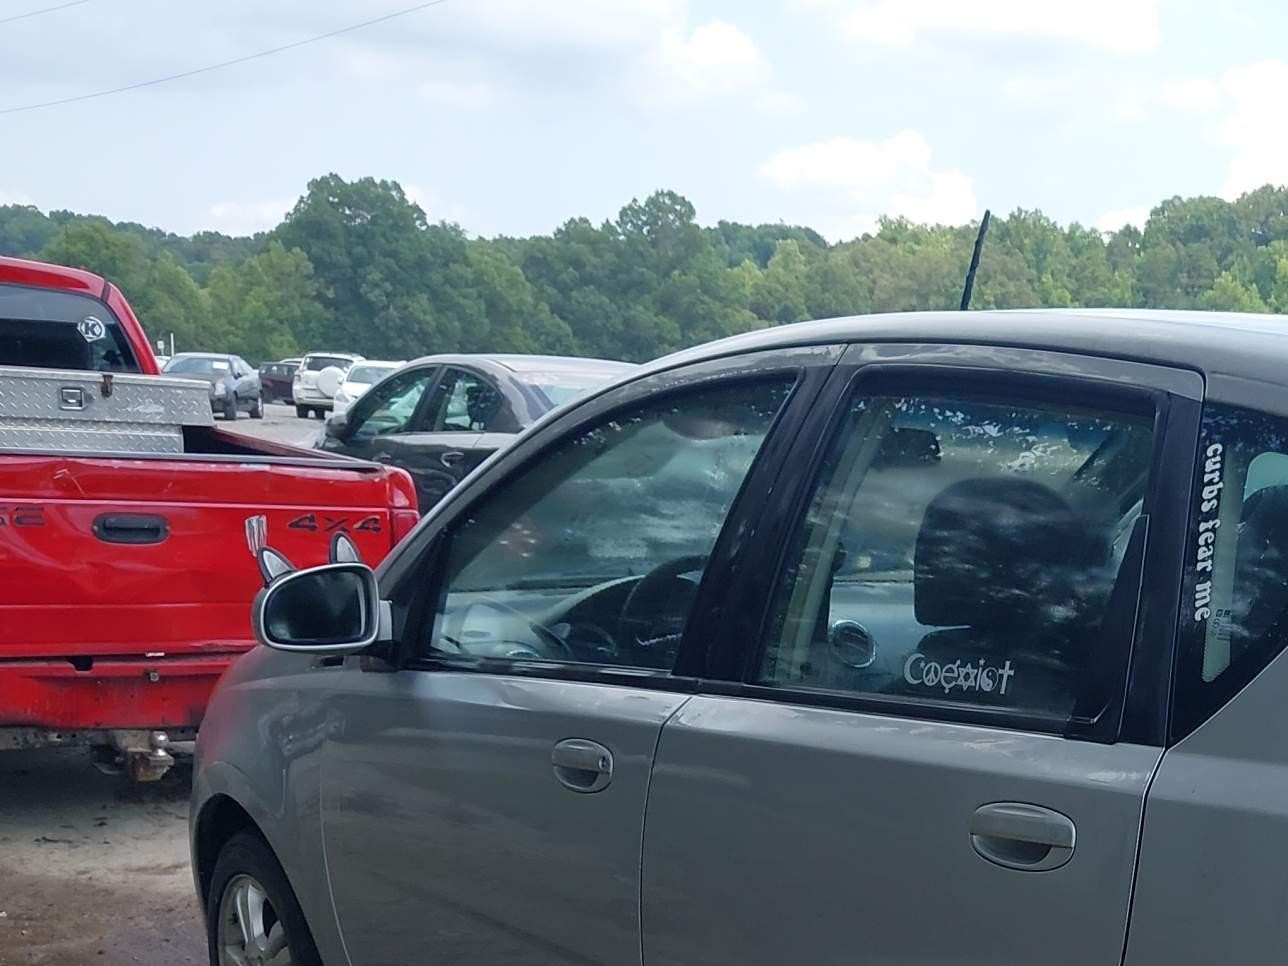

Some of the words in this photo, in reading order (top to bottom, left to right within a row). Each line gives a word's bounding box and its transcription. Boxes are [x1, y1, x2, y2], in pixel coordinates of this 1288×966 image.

[1200, 442, 1224, 513] curbs
[1196, 518, 1221, 573] fear
[1194, 580, 1213, 622] me
